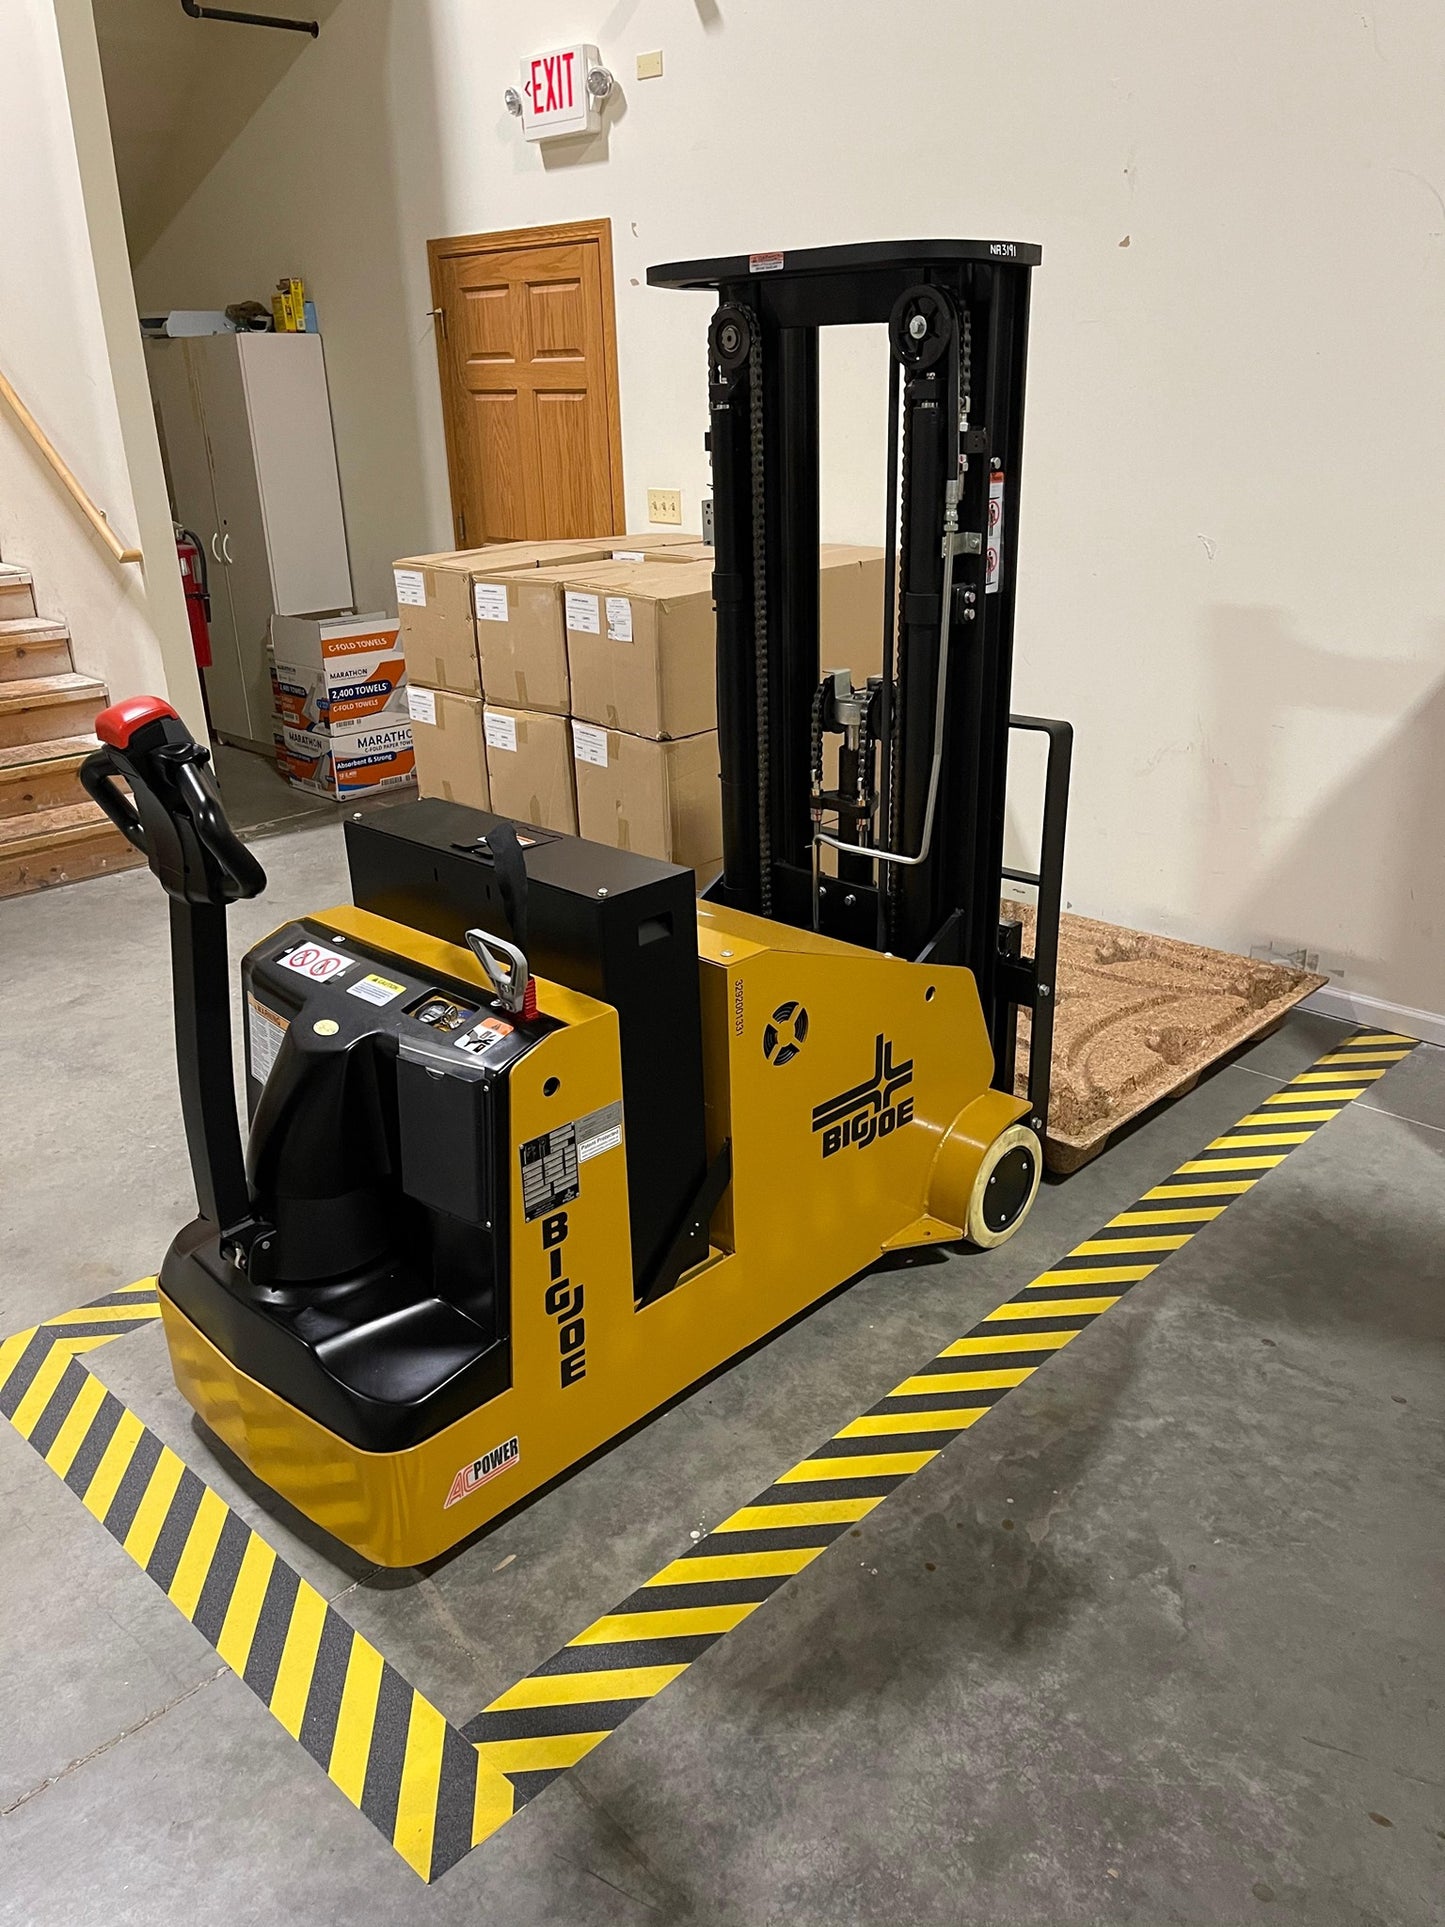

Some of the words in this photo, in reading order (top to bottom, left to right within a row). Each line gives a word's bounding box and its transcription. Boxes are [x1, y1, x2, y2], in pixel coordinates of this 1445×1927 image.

[531, 52, 574, 115] EXIT
[990, 244, 1017, 257] NA3191
[328, 640, 356, 653] C-FOLD
[357, 637, 388, 648] TOWELS
[329, 668, 368, 680] MARATHON
[331, 688, 354, 700] 2,400
[332, 703, 354, 713] C-FOLD
[354, 699, 379, 709] TOWELS
[289, 731, 322, 750] MARATHON
[357, 729, 413, 748] MARATHO
[383, 742, 399, 751] PAPER
[336, 757, 367, 770] Absorbent
[373, 753, 393, 763] Strong
[580, 1140, 597, 1151] Patent
[473, 1437, 518, 1481] POWER
